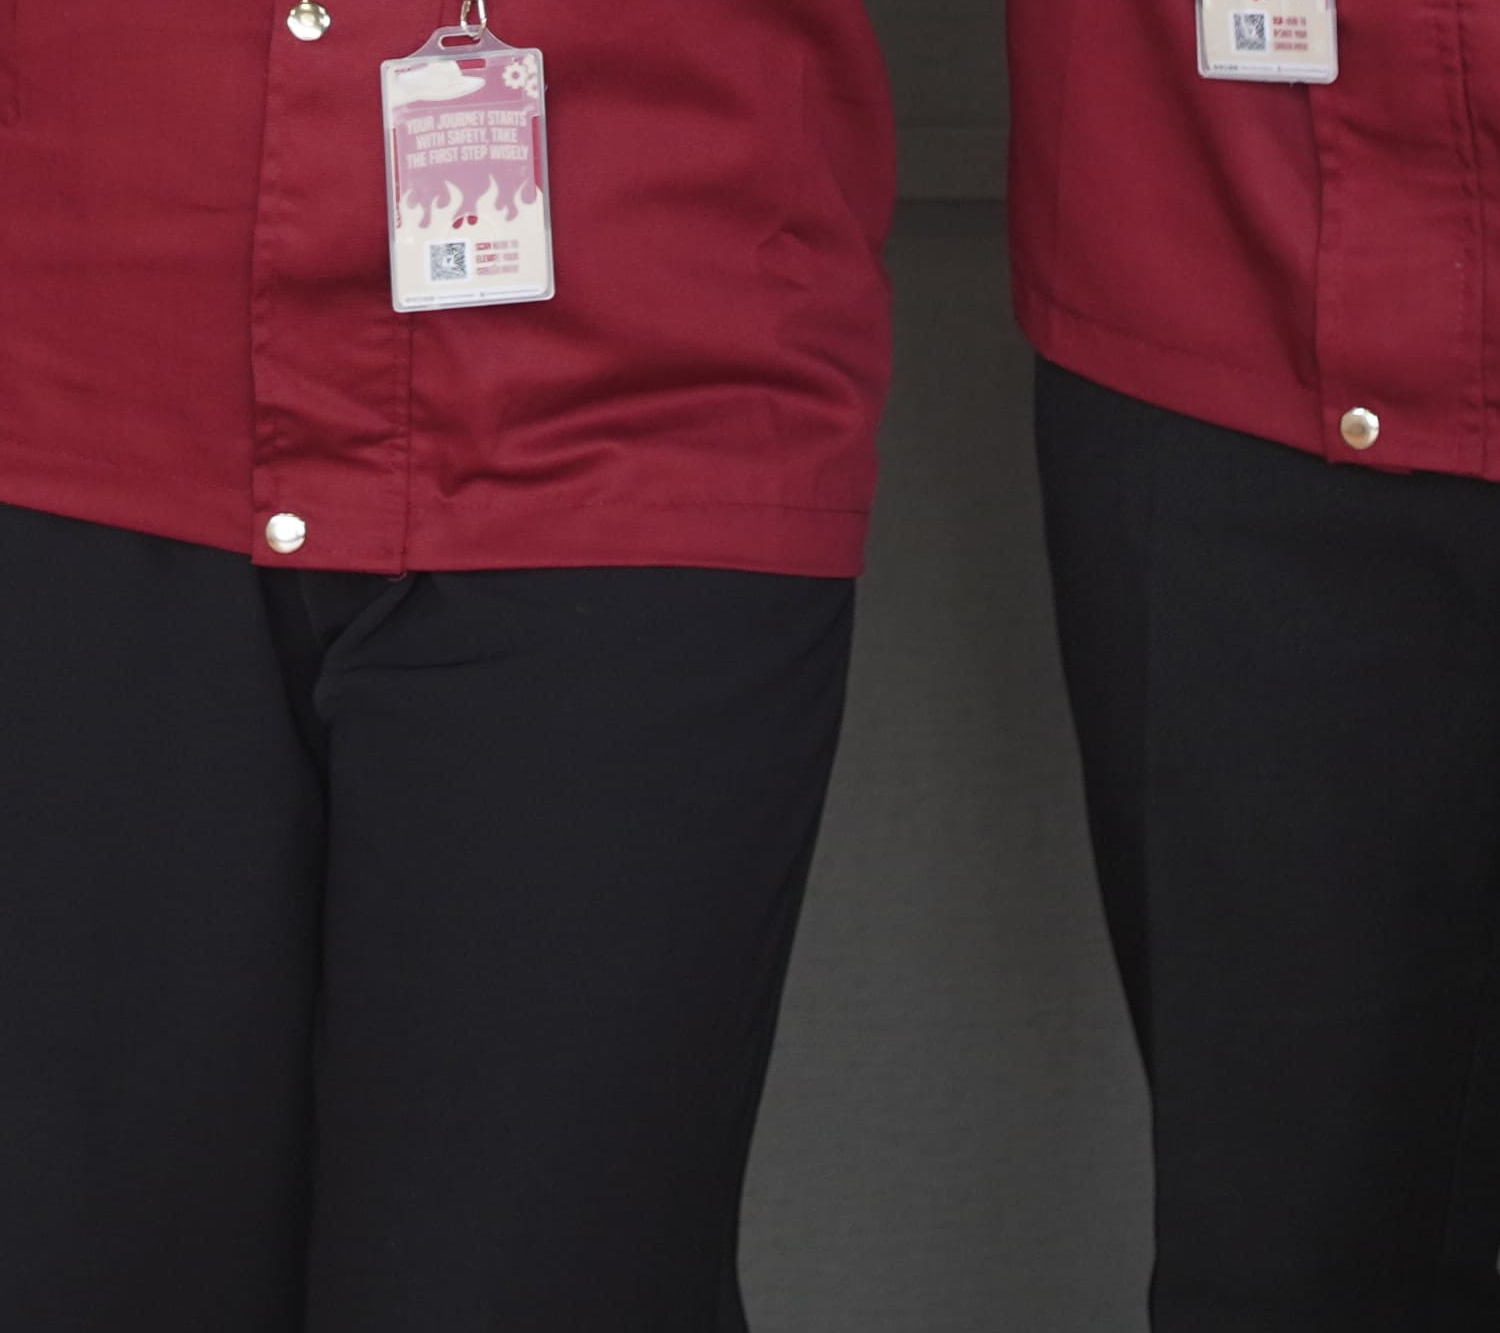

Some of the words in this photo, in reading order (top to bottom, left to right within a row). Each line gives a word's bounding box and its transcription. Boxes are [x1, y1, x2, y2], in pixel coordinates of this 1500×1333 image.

[407, 116, 435, 135] YOUR
[436, 111, 485, 130] JOURNEY
[487, 110, 527, 127] STARTS
[415, 131, 445, 150] WITH
[491, 128, 518, 143] TAKE
[407, 151, 427, 169] THE
[428, 147, 458, 165] FIRST
[460, 145, 488, 161] STEP
[489, 144, 529, 161] WISELY
